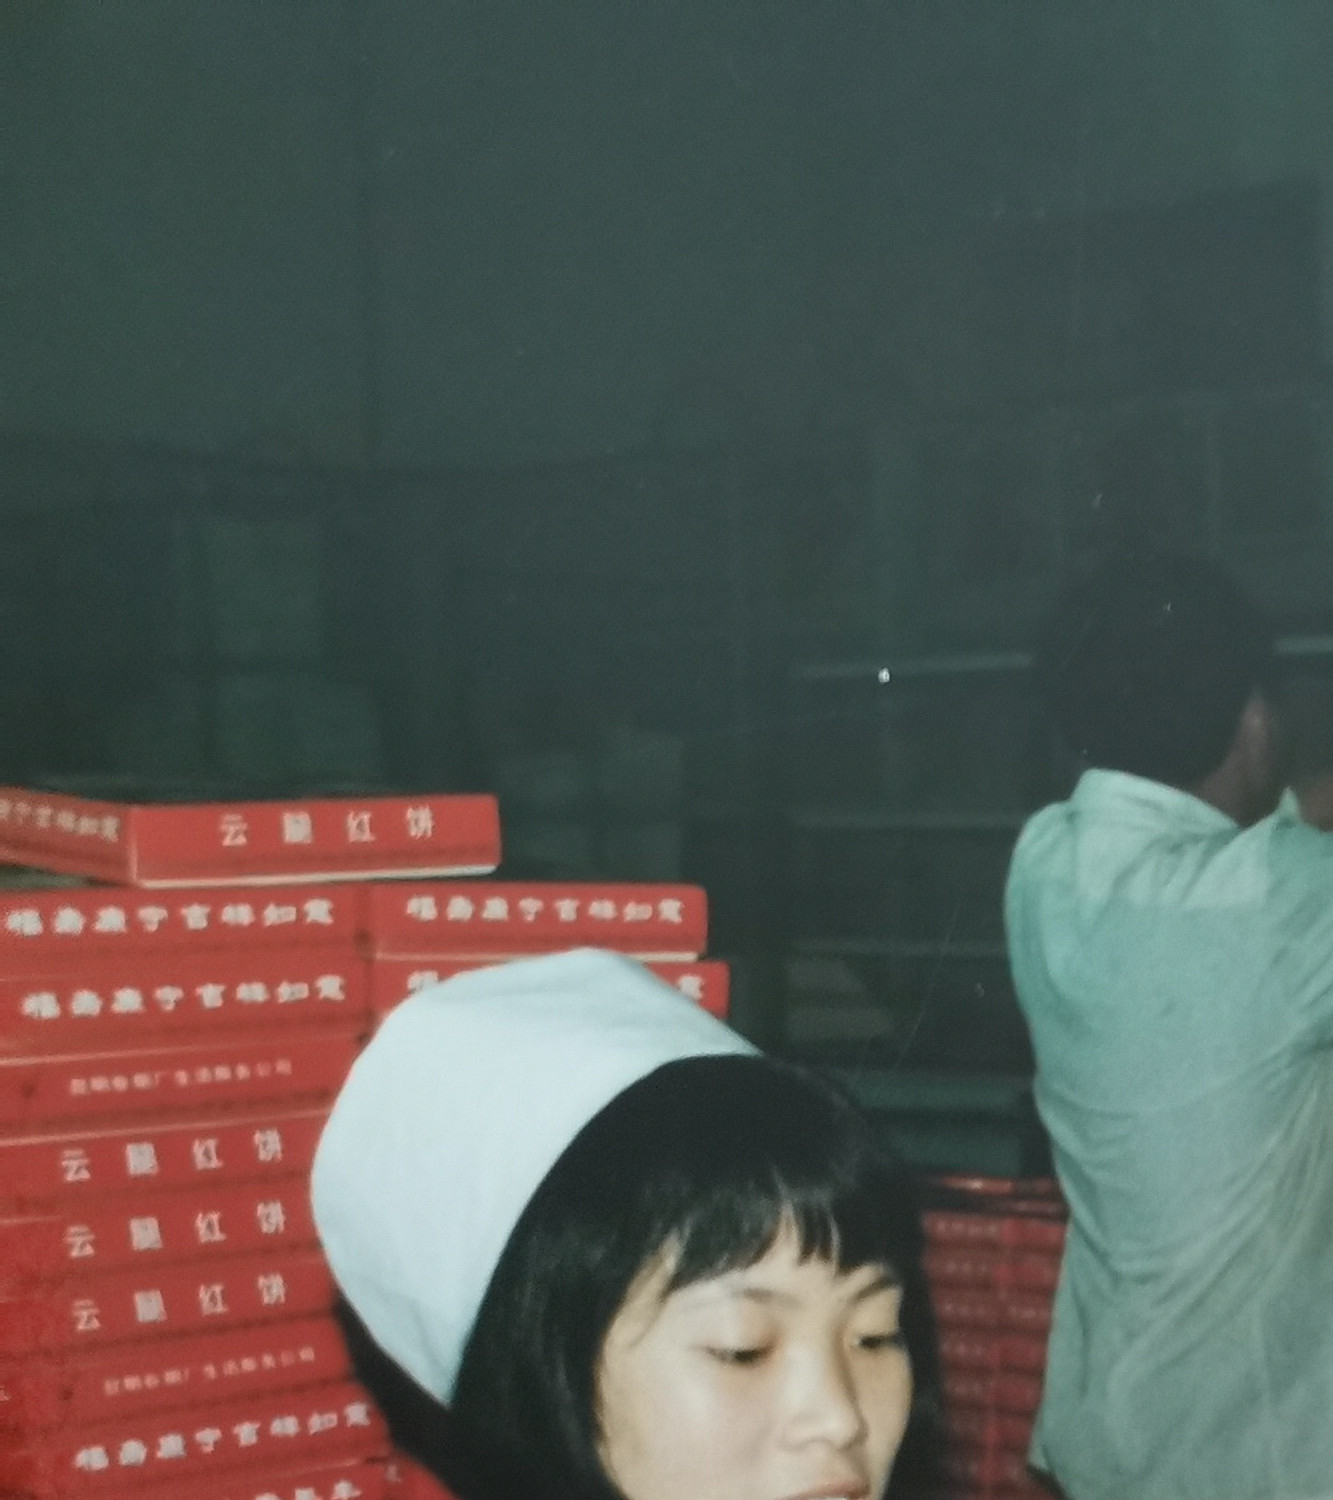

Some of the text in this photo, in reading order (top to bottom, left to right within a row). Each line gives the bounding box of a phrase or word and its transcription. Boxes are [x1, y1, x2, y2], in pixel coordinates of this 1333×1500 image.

[221, 804, 434, 846] 云腿红饼
[60, 1128, 284, 1182] 云腿红饼
[65, 1201, 287, 1258] 云腿红饼
[72, 1273, 287, 1332] 云腿红饼
